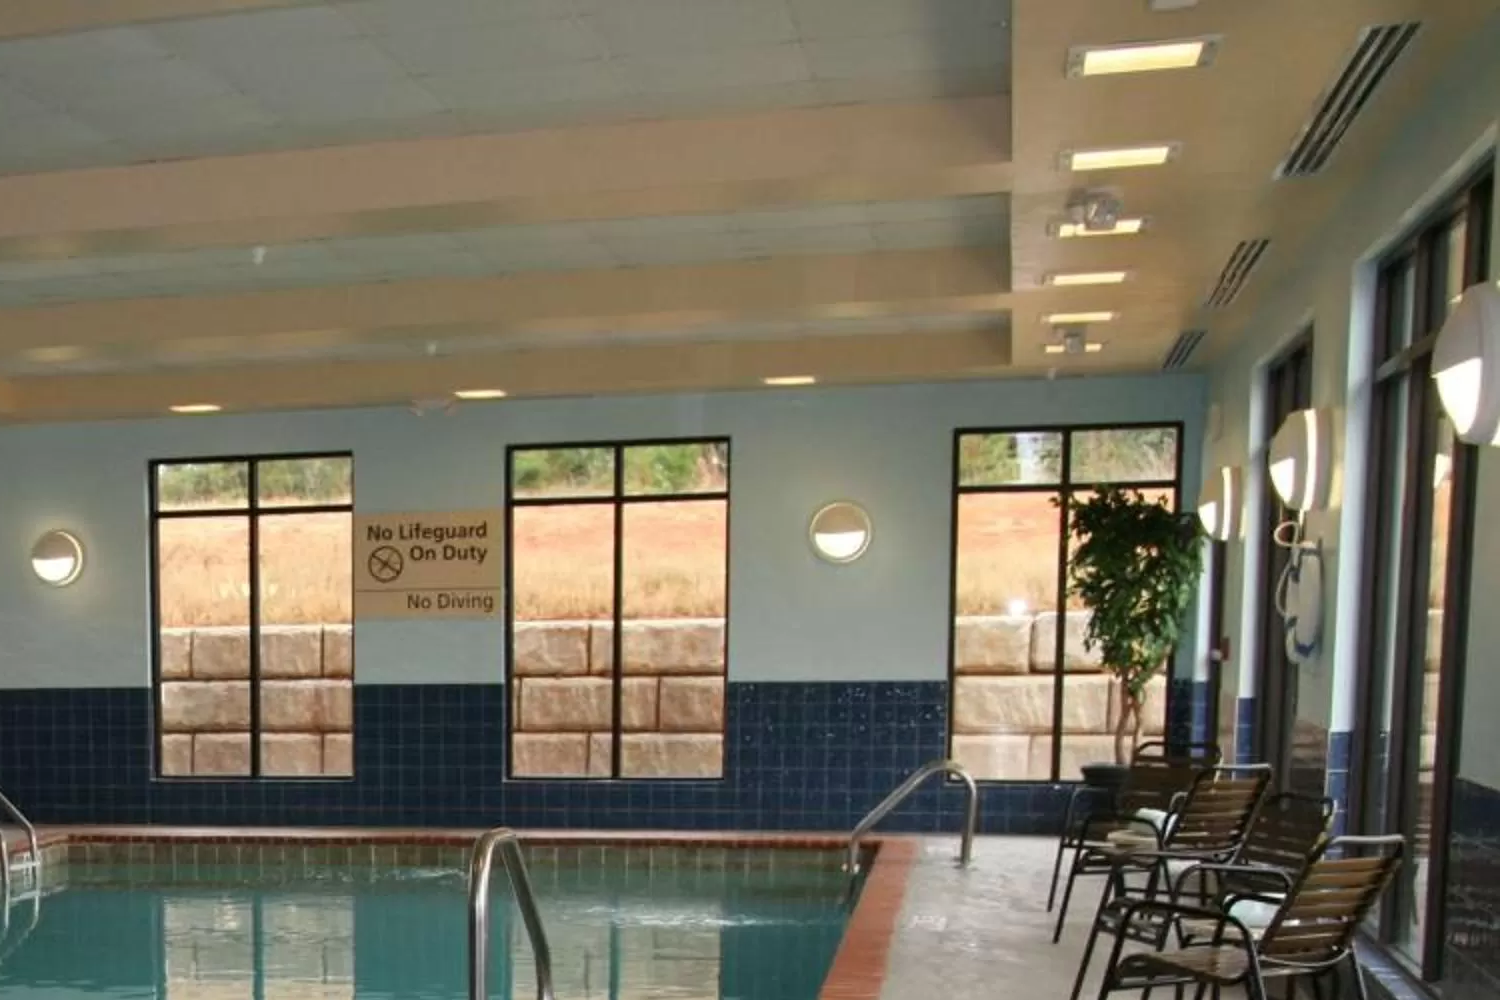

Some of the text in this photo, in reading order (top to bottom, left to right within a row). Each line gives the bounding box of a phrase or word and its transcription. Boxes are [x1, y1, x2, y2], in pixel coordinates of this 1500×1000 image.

[367, 520, 487, 543] No Lifeguard
[409, 545, 488, 564] On Duty
[407, 592, 494, 613] No Diving
